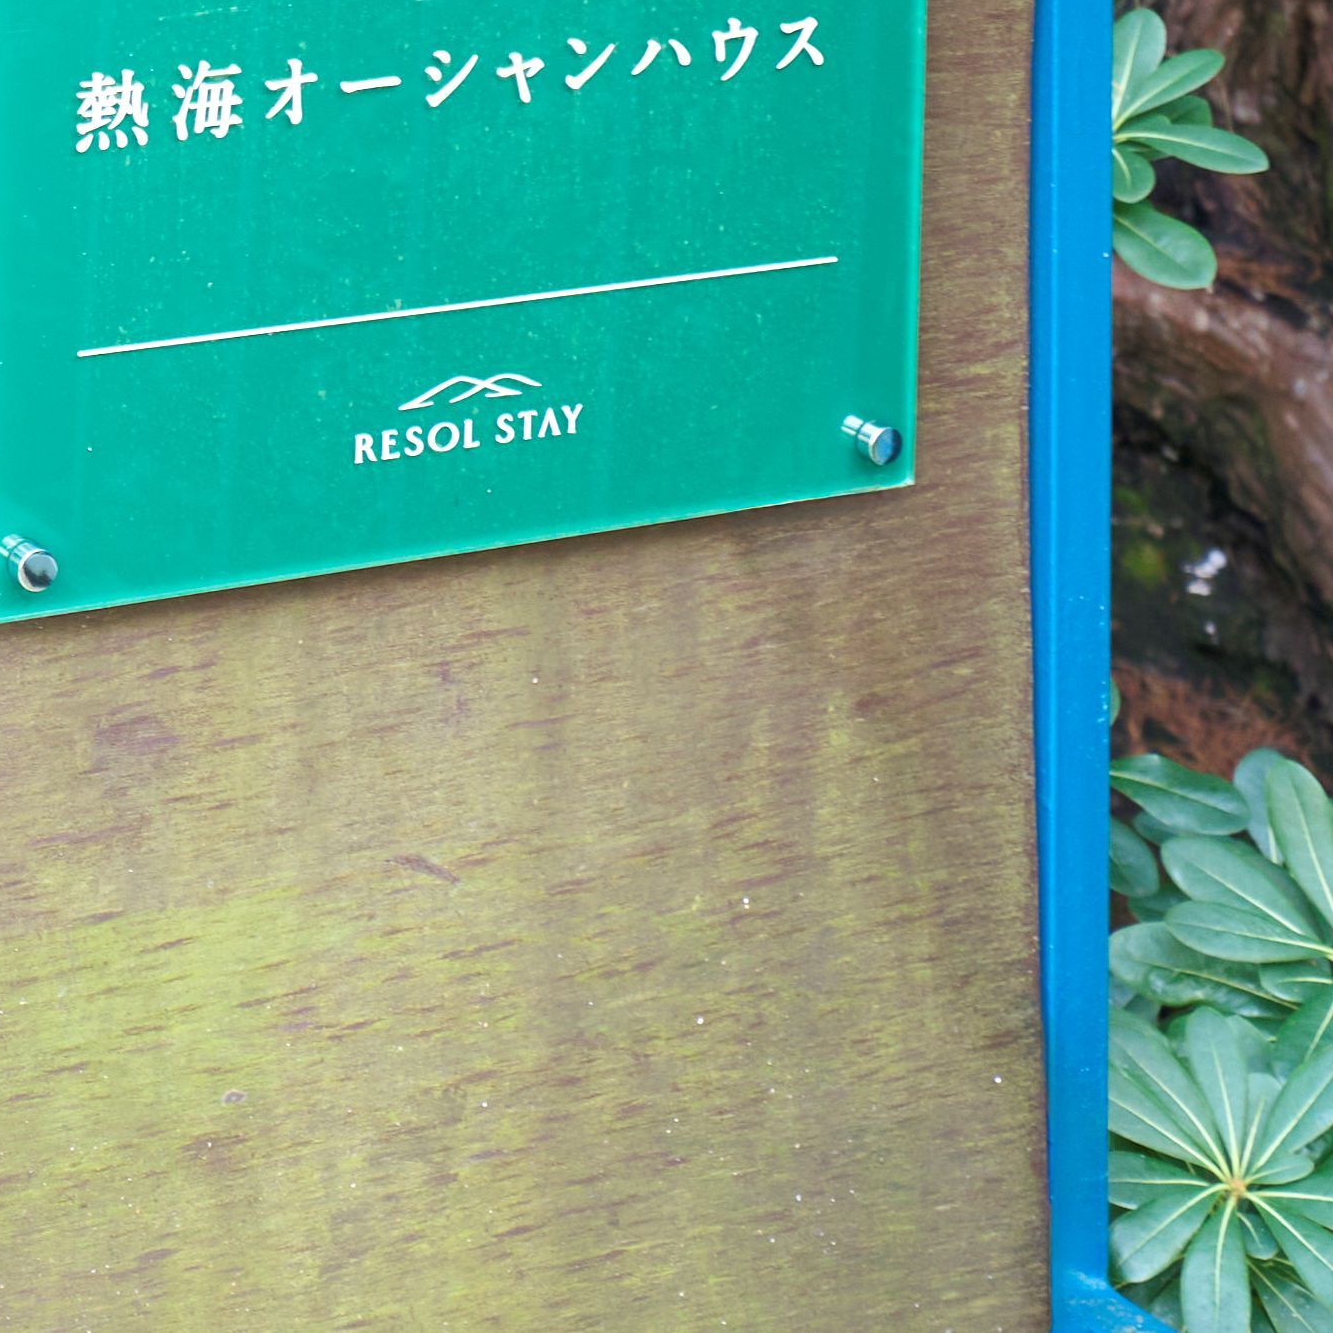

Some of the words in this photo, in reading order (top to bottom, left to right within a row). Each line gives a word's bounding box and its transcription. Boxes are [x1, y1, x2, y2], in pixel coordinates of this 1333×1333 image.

[75, 16, 825, 154] 熱海オーシャンハウス
[353, 418, 481, 465] RESOL
[494, 403, 584, 445] STAY
